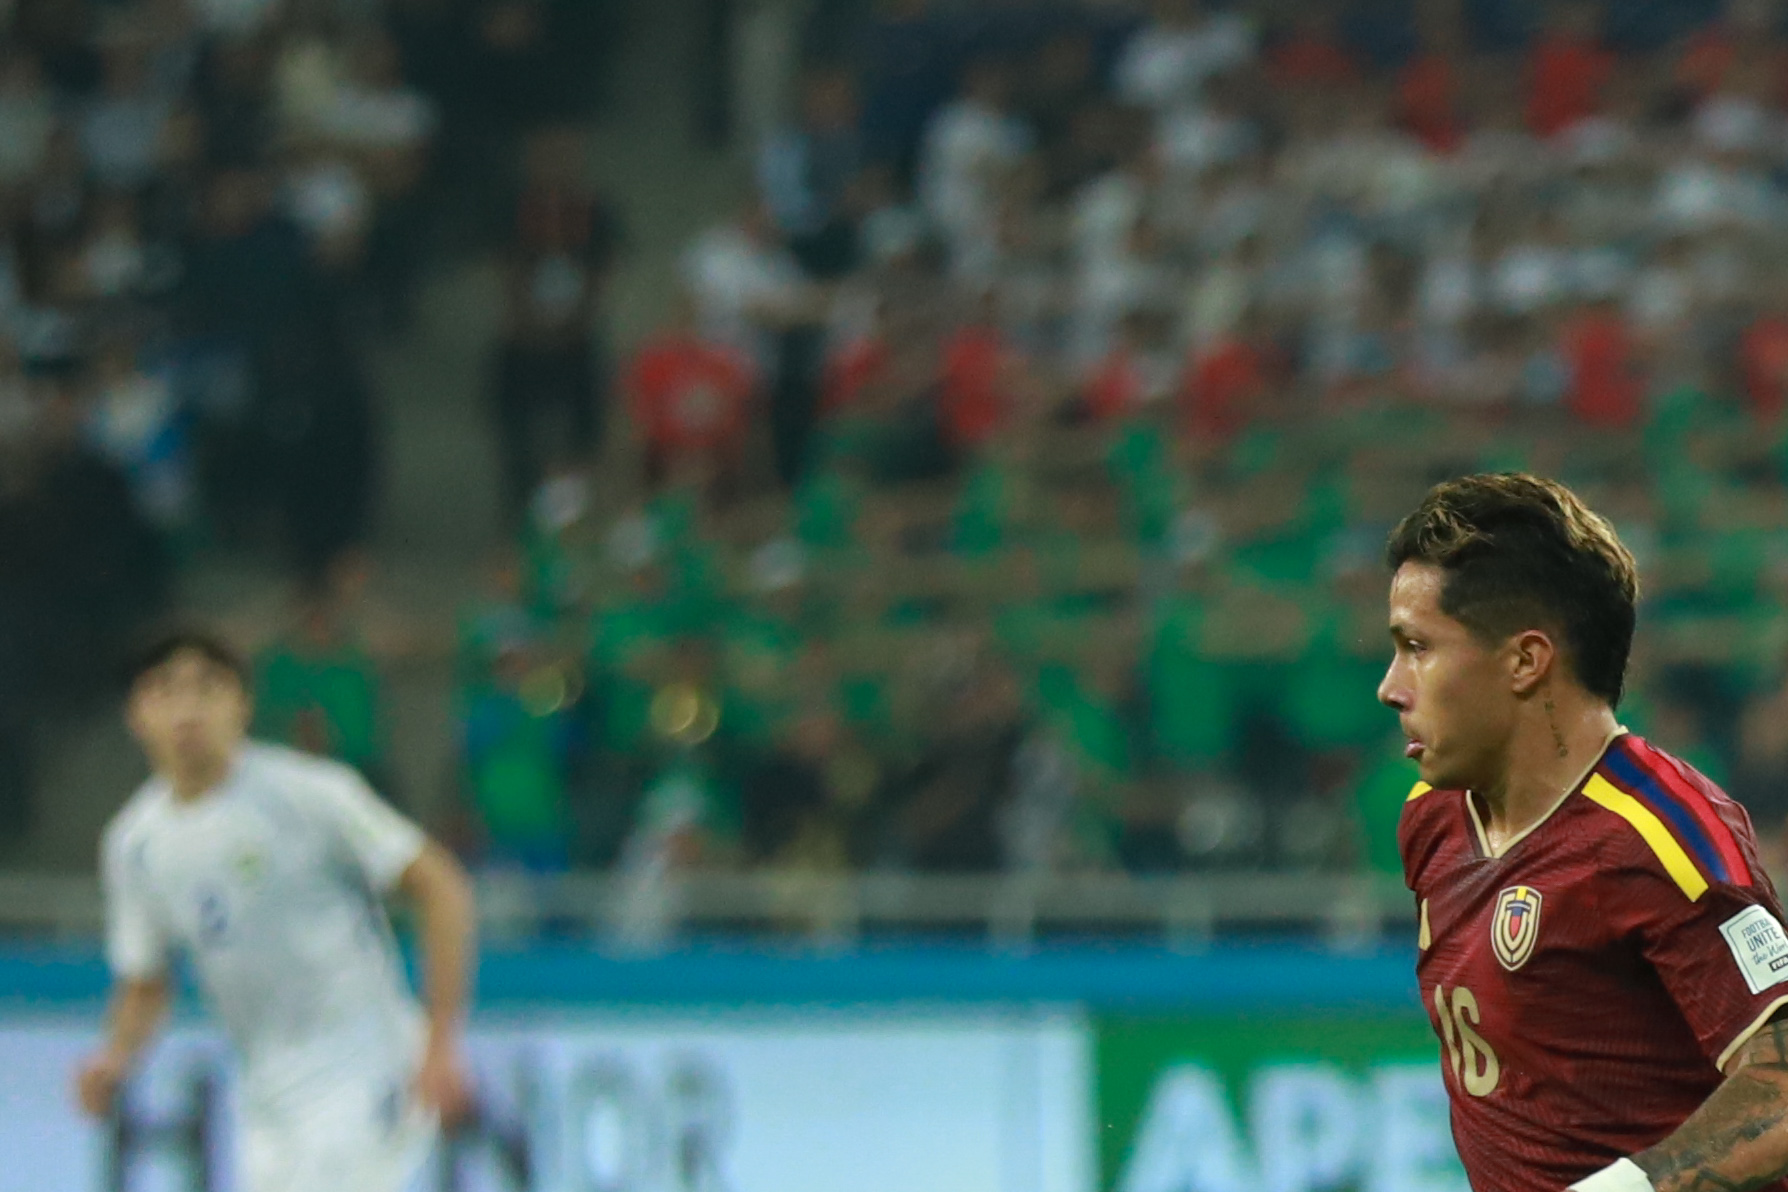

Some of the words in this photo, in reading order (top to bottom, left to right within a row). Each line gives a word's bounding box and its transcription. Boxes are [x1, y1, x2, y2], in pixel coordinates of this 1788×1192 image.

[1741, 918, 1773, 938] FOOTBA
[1746, 927, 1781, 952] UNITE
[1752, 951, 1768, 965] the
[1434, 984, 1499, 1097] 16
